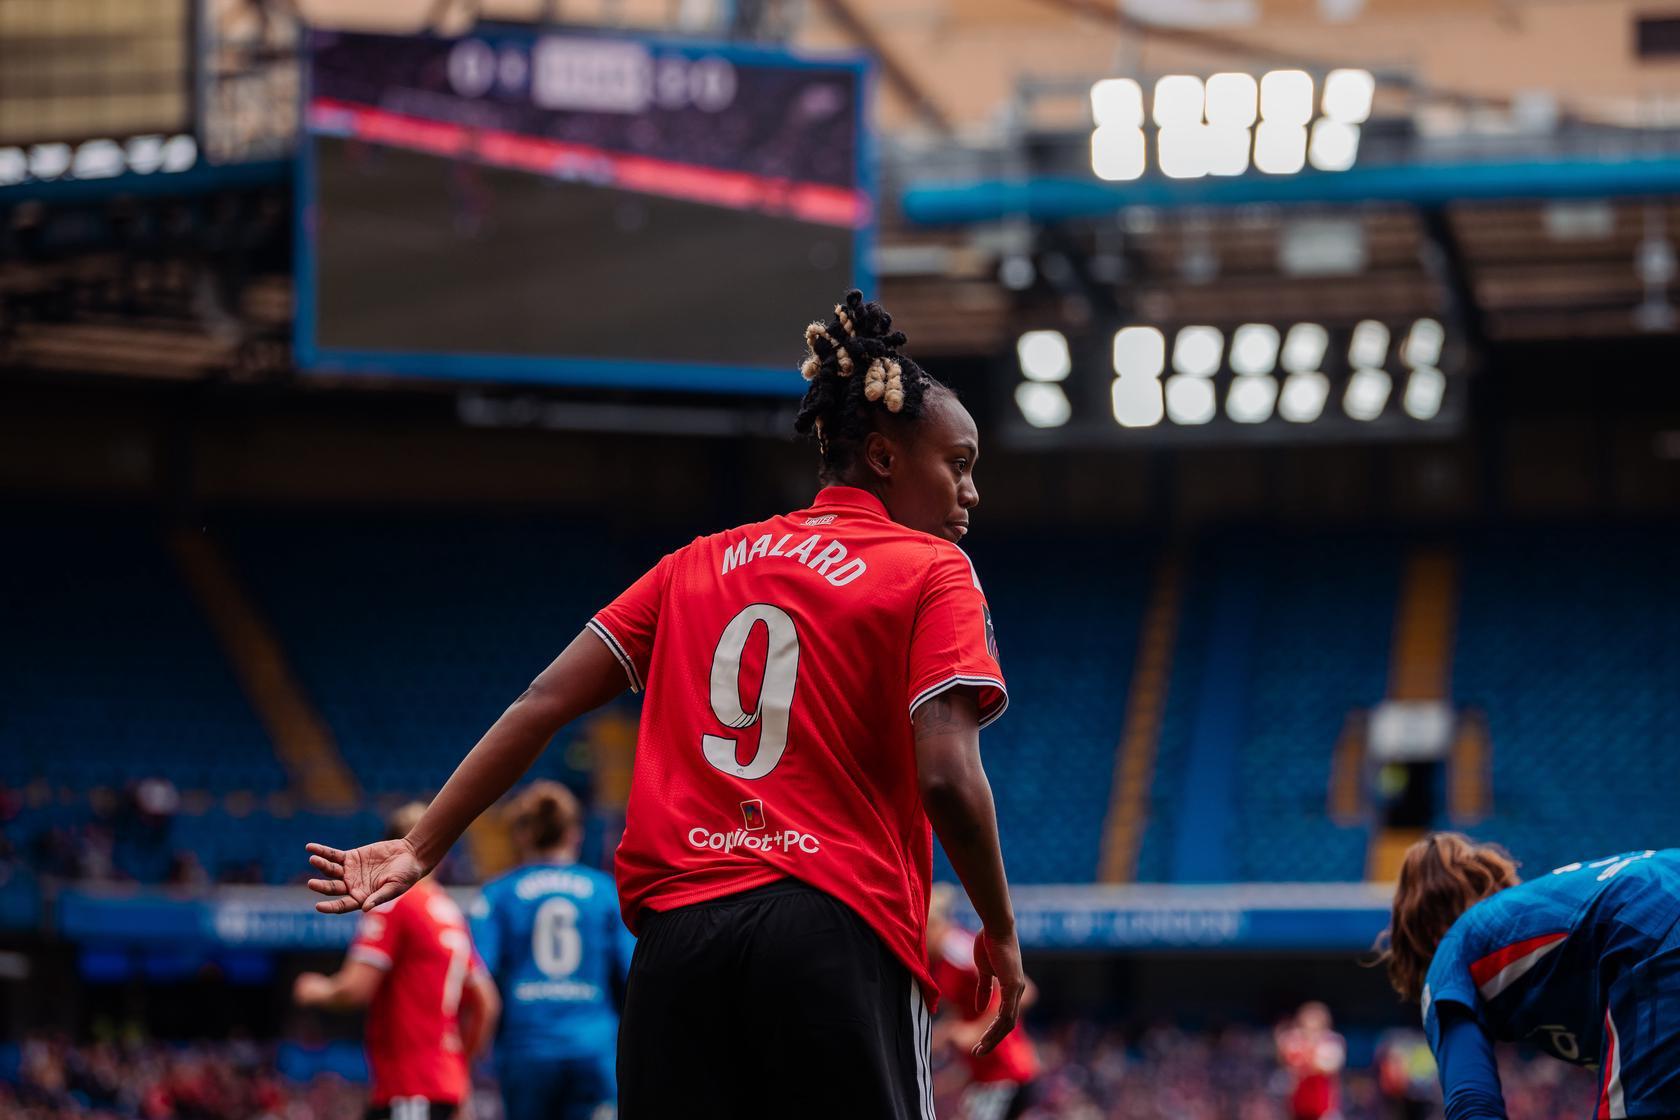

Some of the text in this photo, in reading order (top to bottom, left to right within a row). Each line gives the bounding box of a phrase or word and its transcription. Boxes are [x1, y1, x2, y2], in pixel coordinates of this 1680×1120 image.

[721, 533, 867, 587] MALARD
[702, 603, 800, 780] 9
[532, 897, 582, 979] 6
